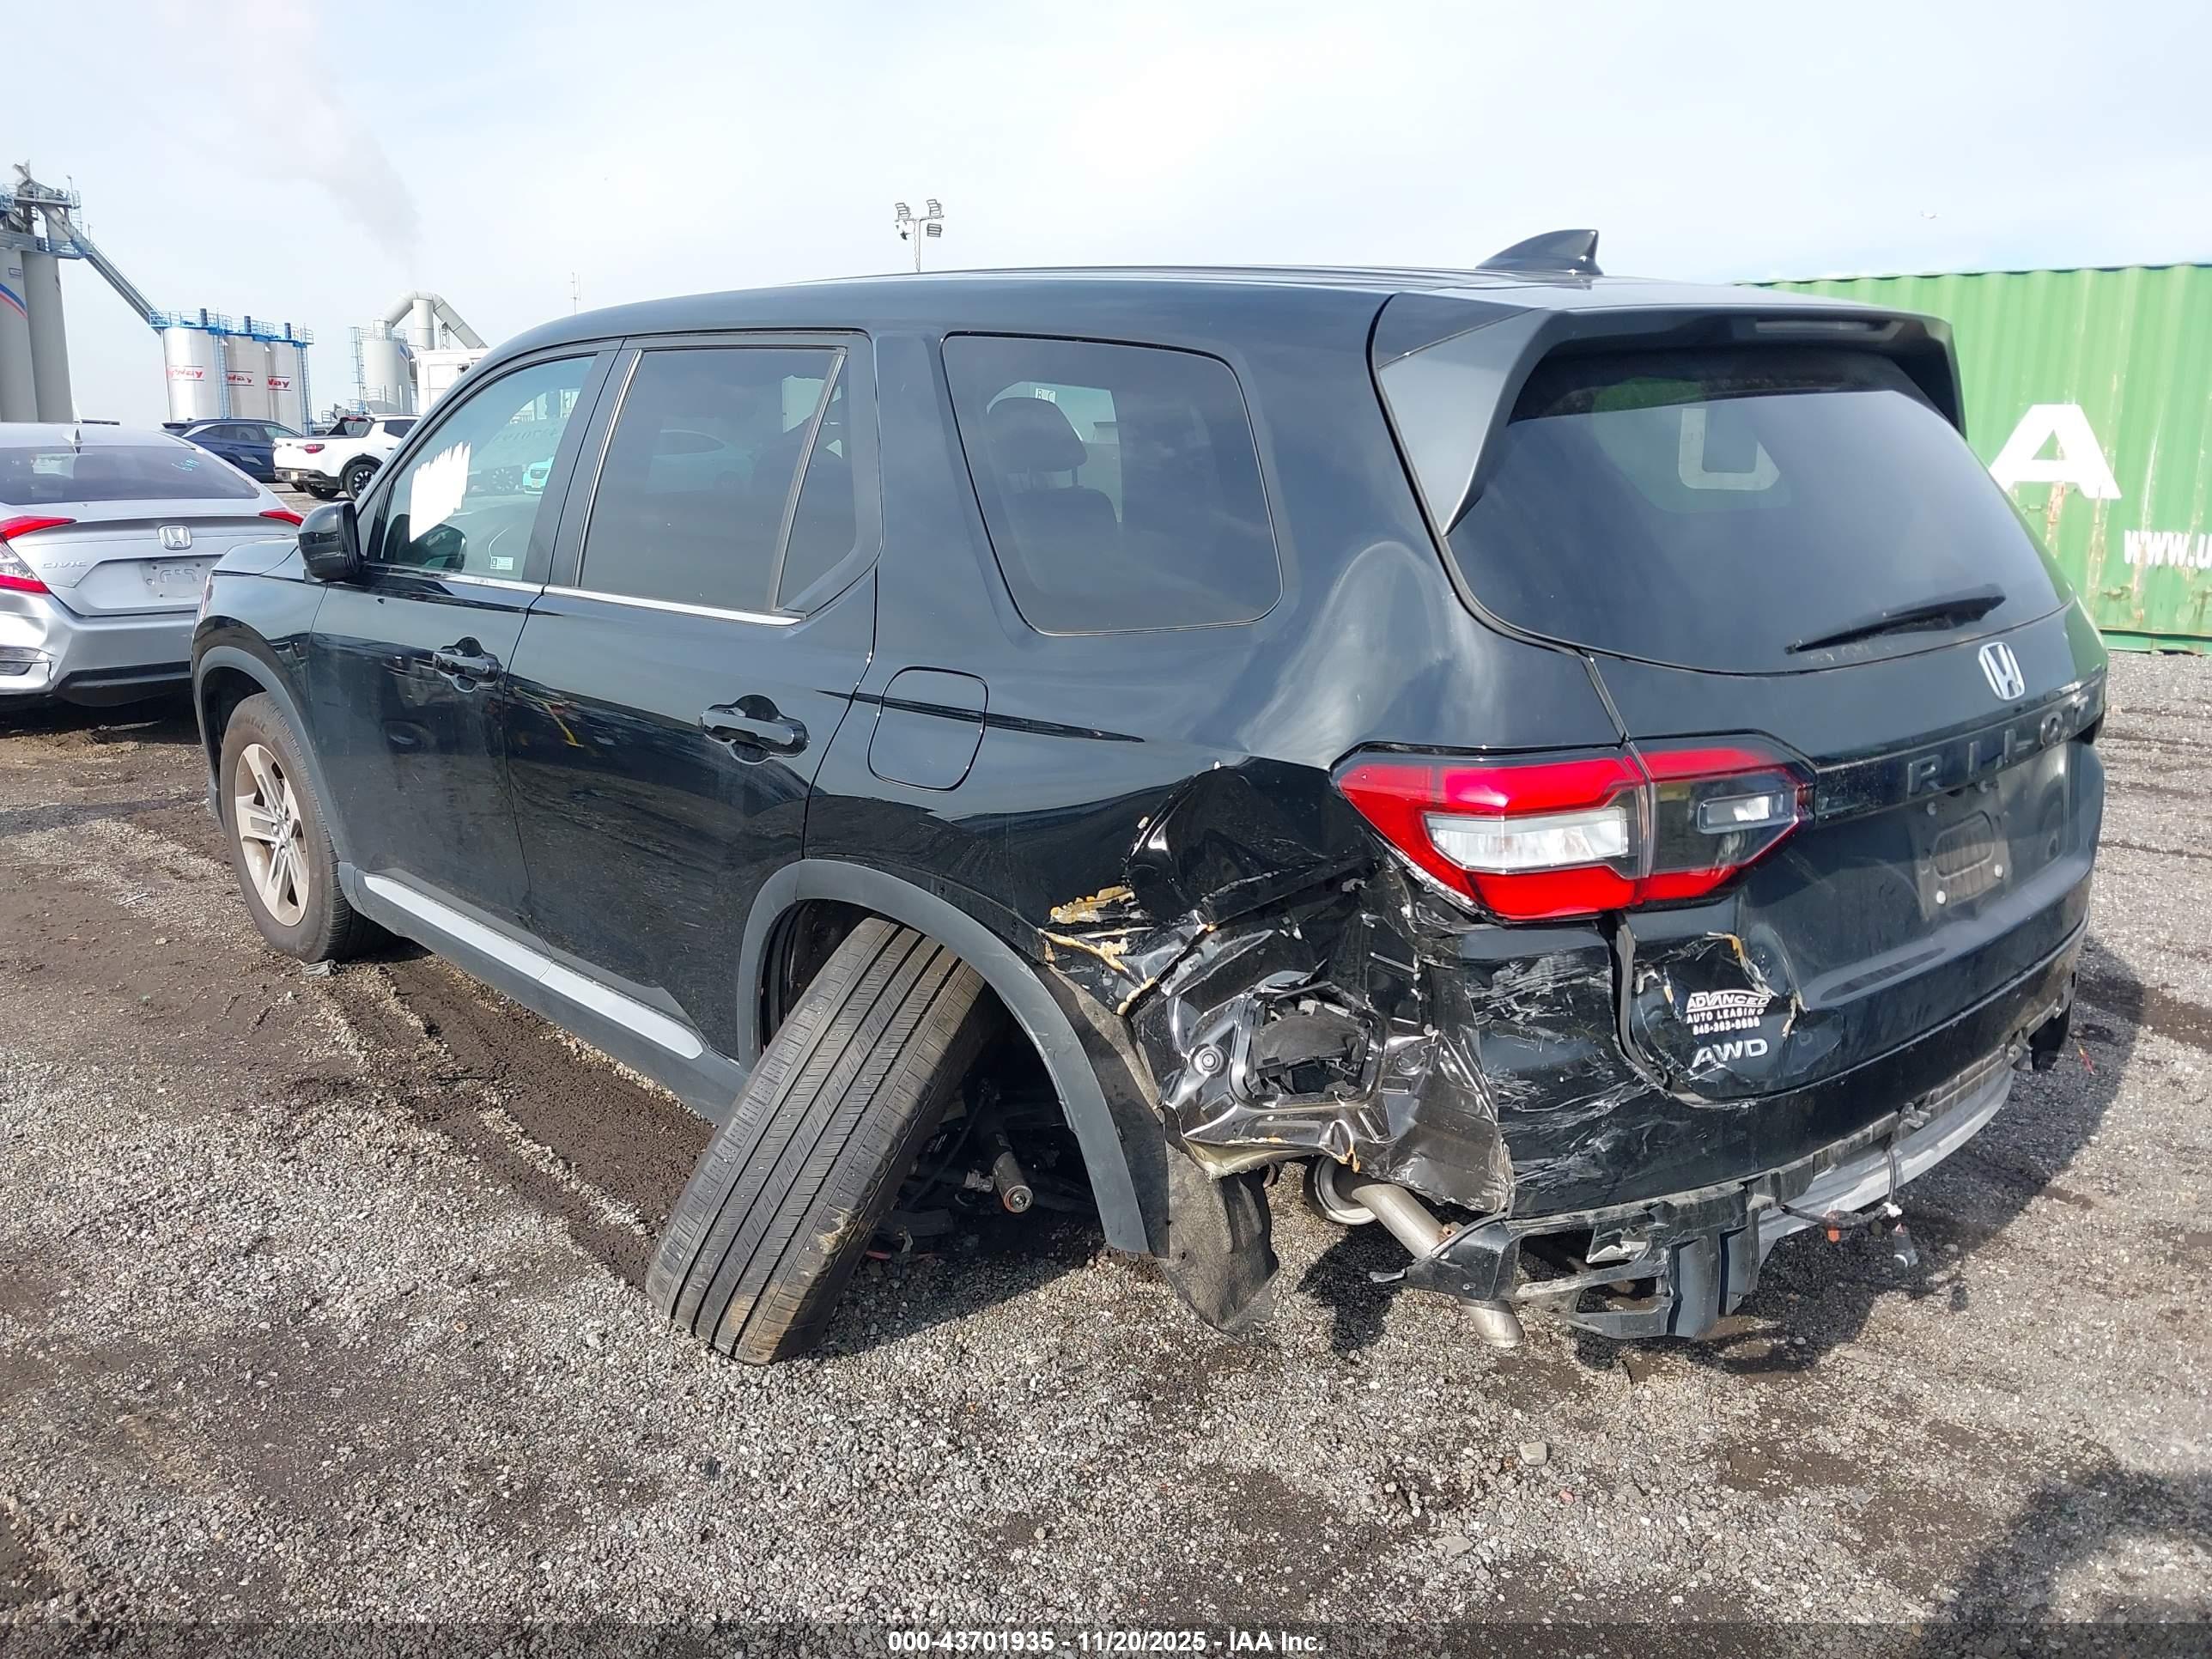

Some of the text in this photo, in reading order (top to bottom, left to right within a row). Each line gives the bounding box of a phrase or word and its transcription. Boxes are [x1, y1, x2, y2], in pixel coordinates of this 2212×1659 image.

[1988, 404, 2122, 499] A
[41, 560, 87, 569] CIVIC
[1907, 695, 2090, 797] PILOT
[1686, 990, 1771, 1012] ADVANCED
[1686, 1006, 1765, 1024] AUTO LEASING
[1692, 1038, 1768, 1067] AWD
